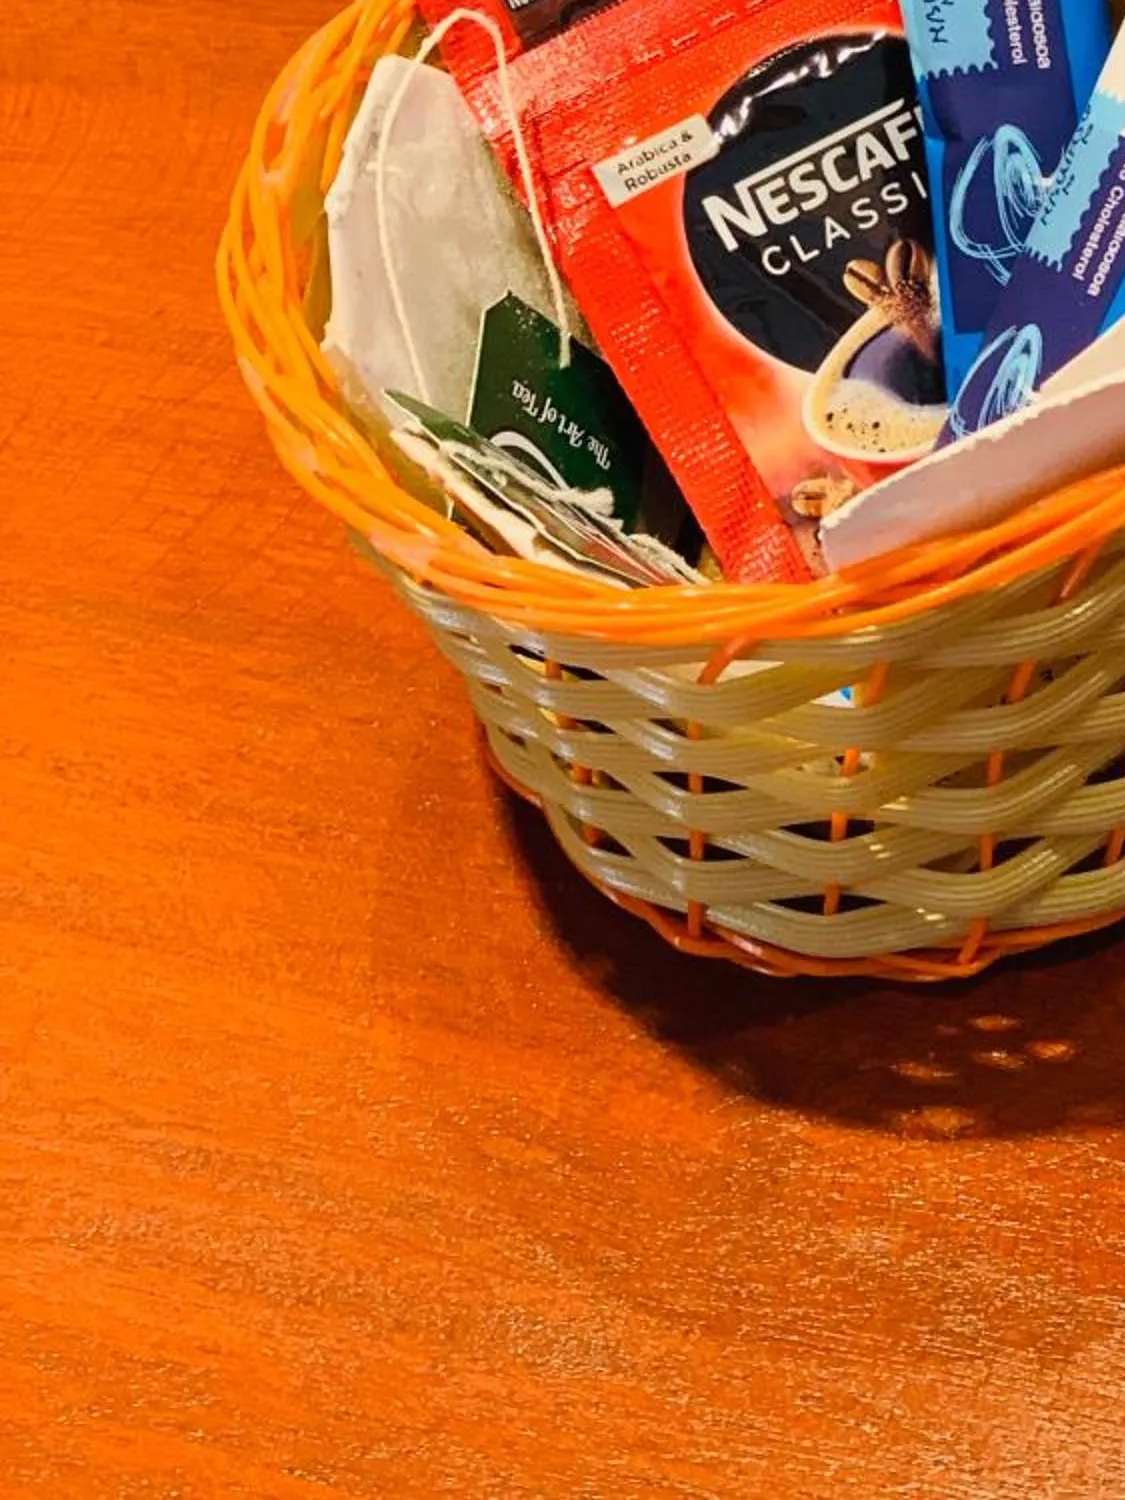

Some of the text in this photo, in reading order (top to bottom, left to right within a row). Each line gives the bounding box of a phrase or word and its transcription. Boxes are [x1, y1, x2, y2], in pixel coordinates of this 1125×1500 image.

[617, 130, 694, 176] Arabica &
[624, 153, 692, 192] Robusta
[701, 98, 925, 252] NESCAF
[761, 171, 927, 275] CLASSI
[1071, 185, 1125, 282] Cholesterol
[512, 379, 611, 470] The Art of Tea
